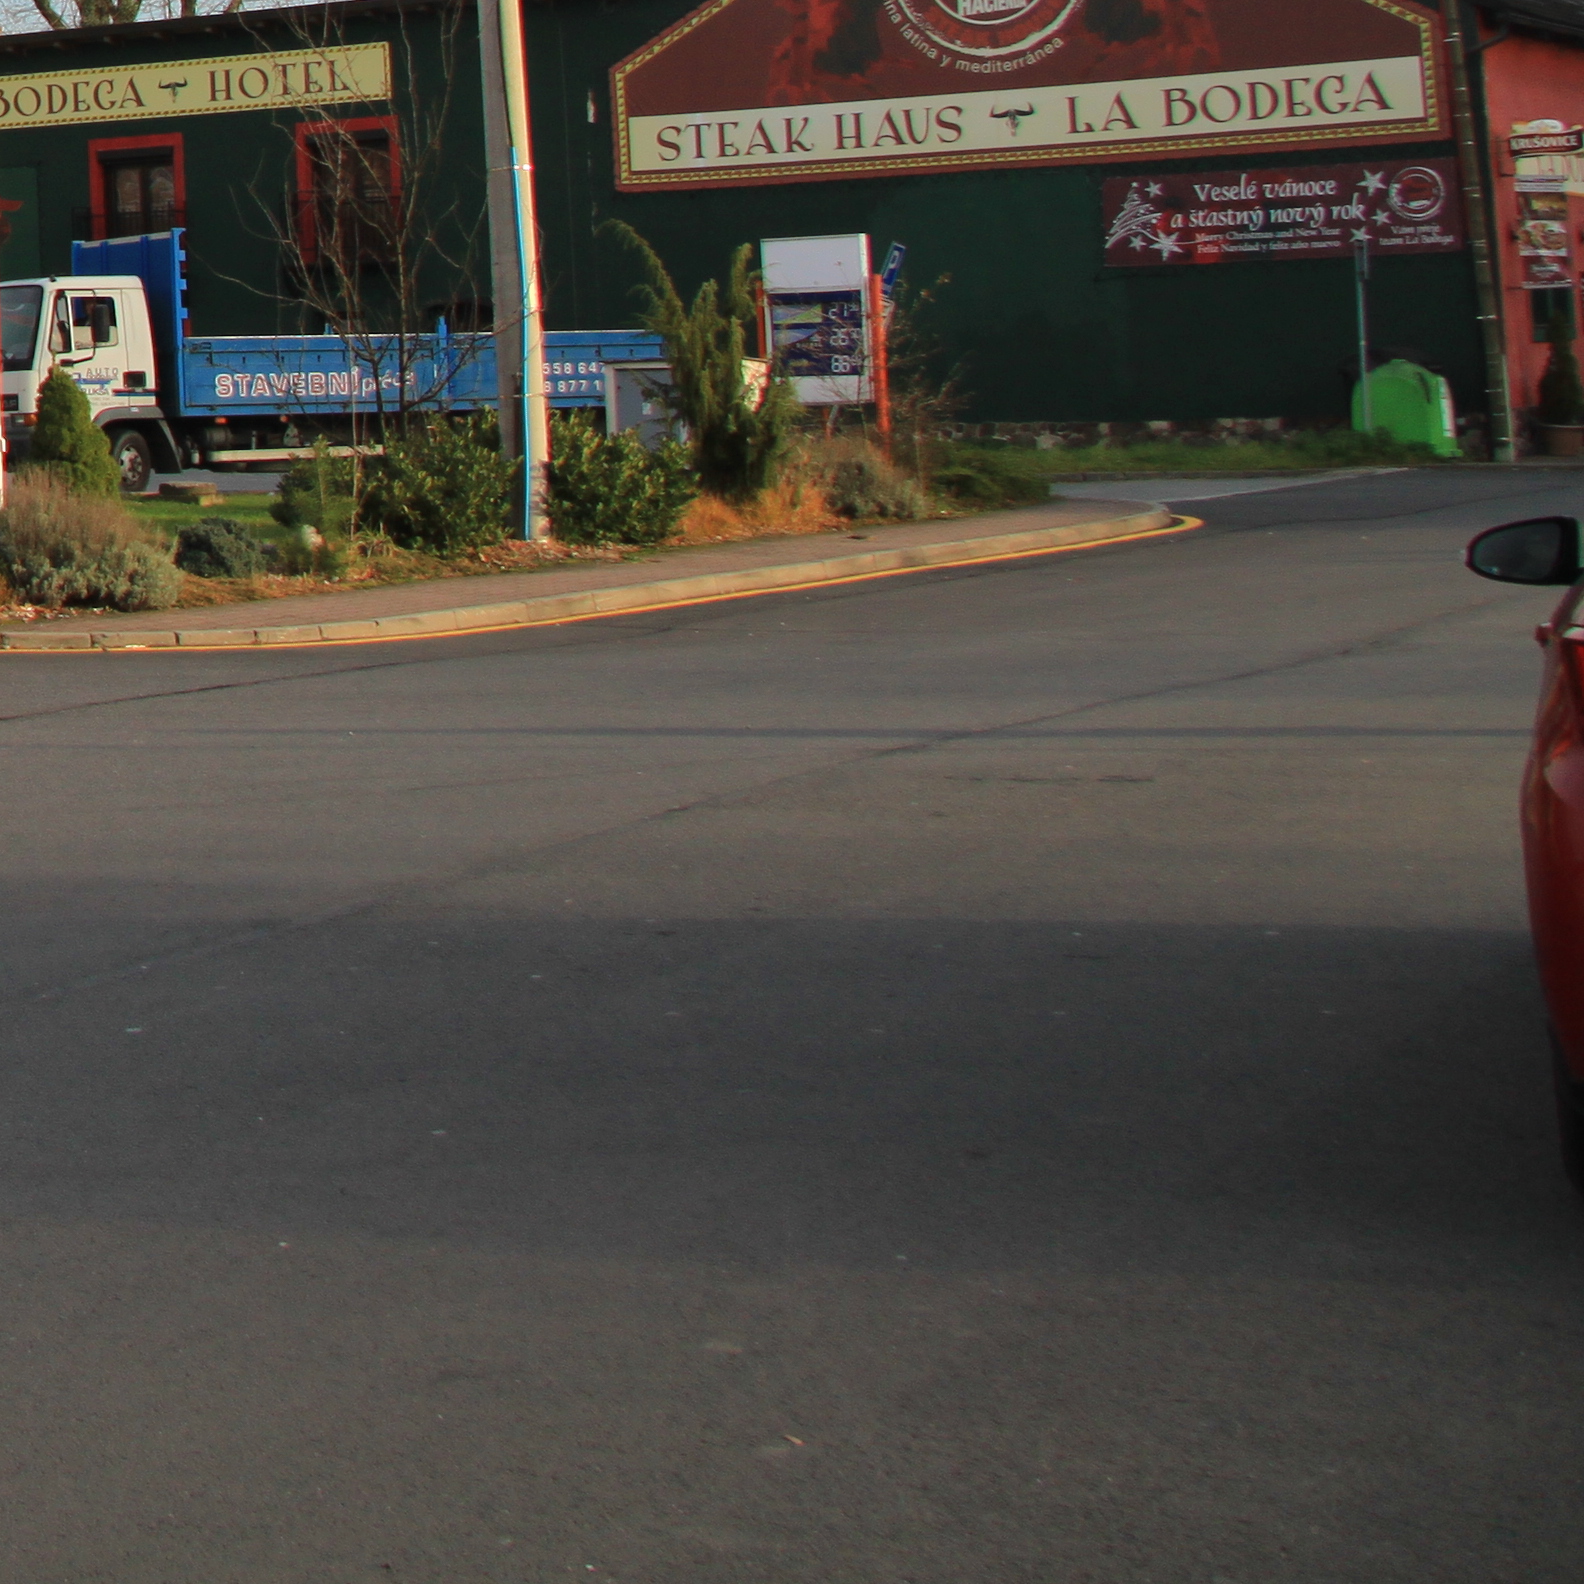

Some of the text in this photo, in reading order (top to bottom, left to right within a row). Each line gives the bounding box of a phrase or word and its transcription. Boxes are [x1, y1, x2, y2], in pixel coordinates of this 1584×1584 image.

[899, 23, 939, 60] latina
[940, 54, 952, 68] y
[955, 36, 1064, 74] mediterránea
[206, 57, 352, 102] HOTEL
[1065, 70, 1395, 137] LA BODEGA
[655, 105, 964, 163] STEAK HAUS
[1170, 213, 1184, 229] a
[1269, 202, 1327, 228] nový
[1330, 192, 1366, 222] rok
[1193, 173, 1338, 203] Veselé vánoce
[215, 367, 360, 398] STAVEBNÍ
